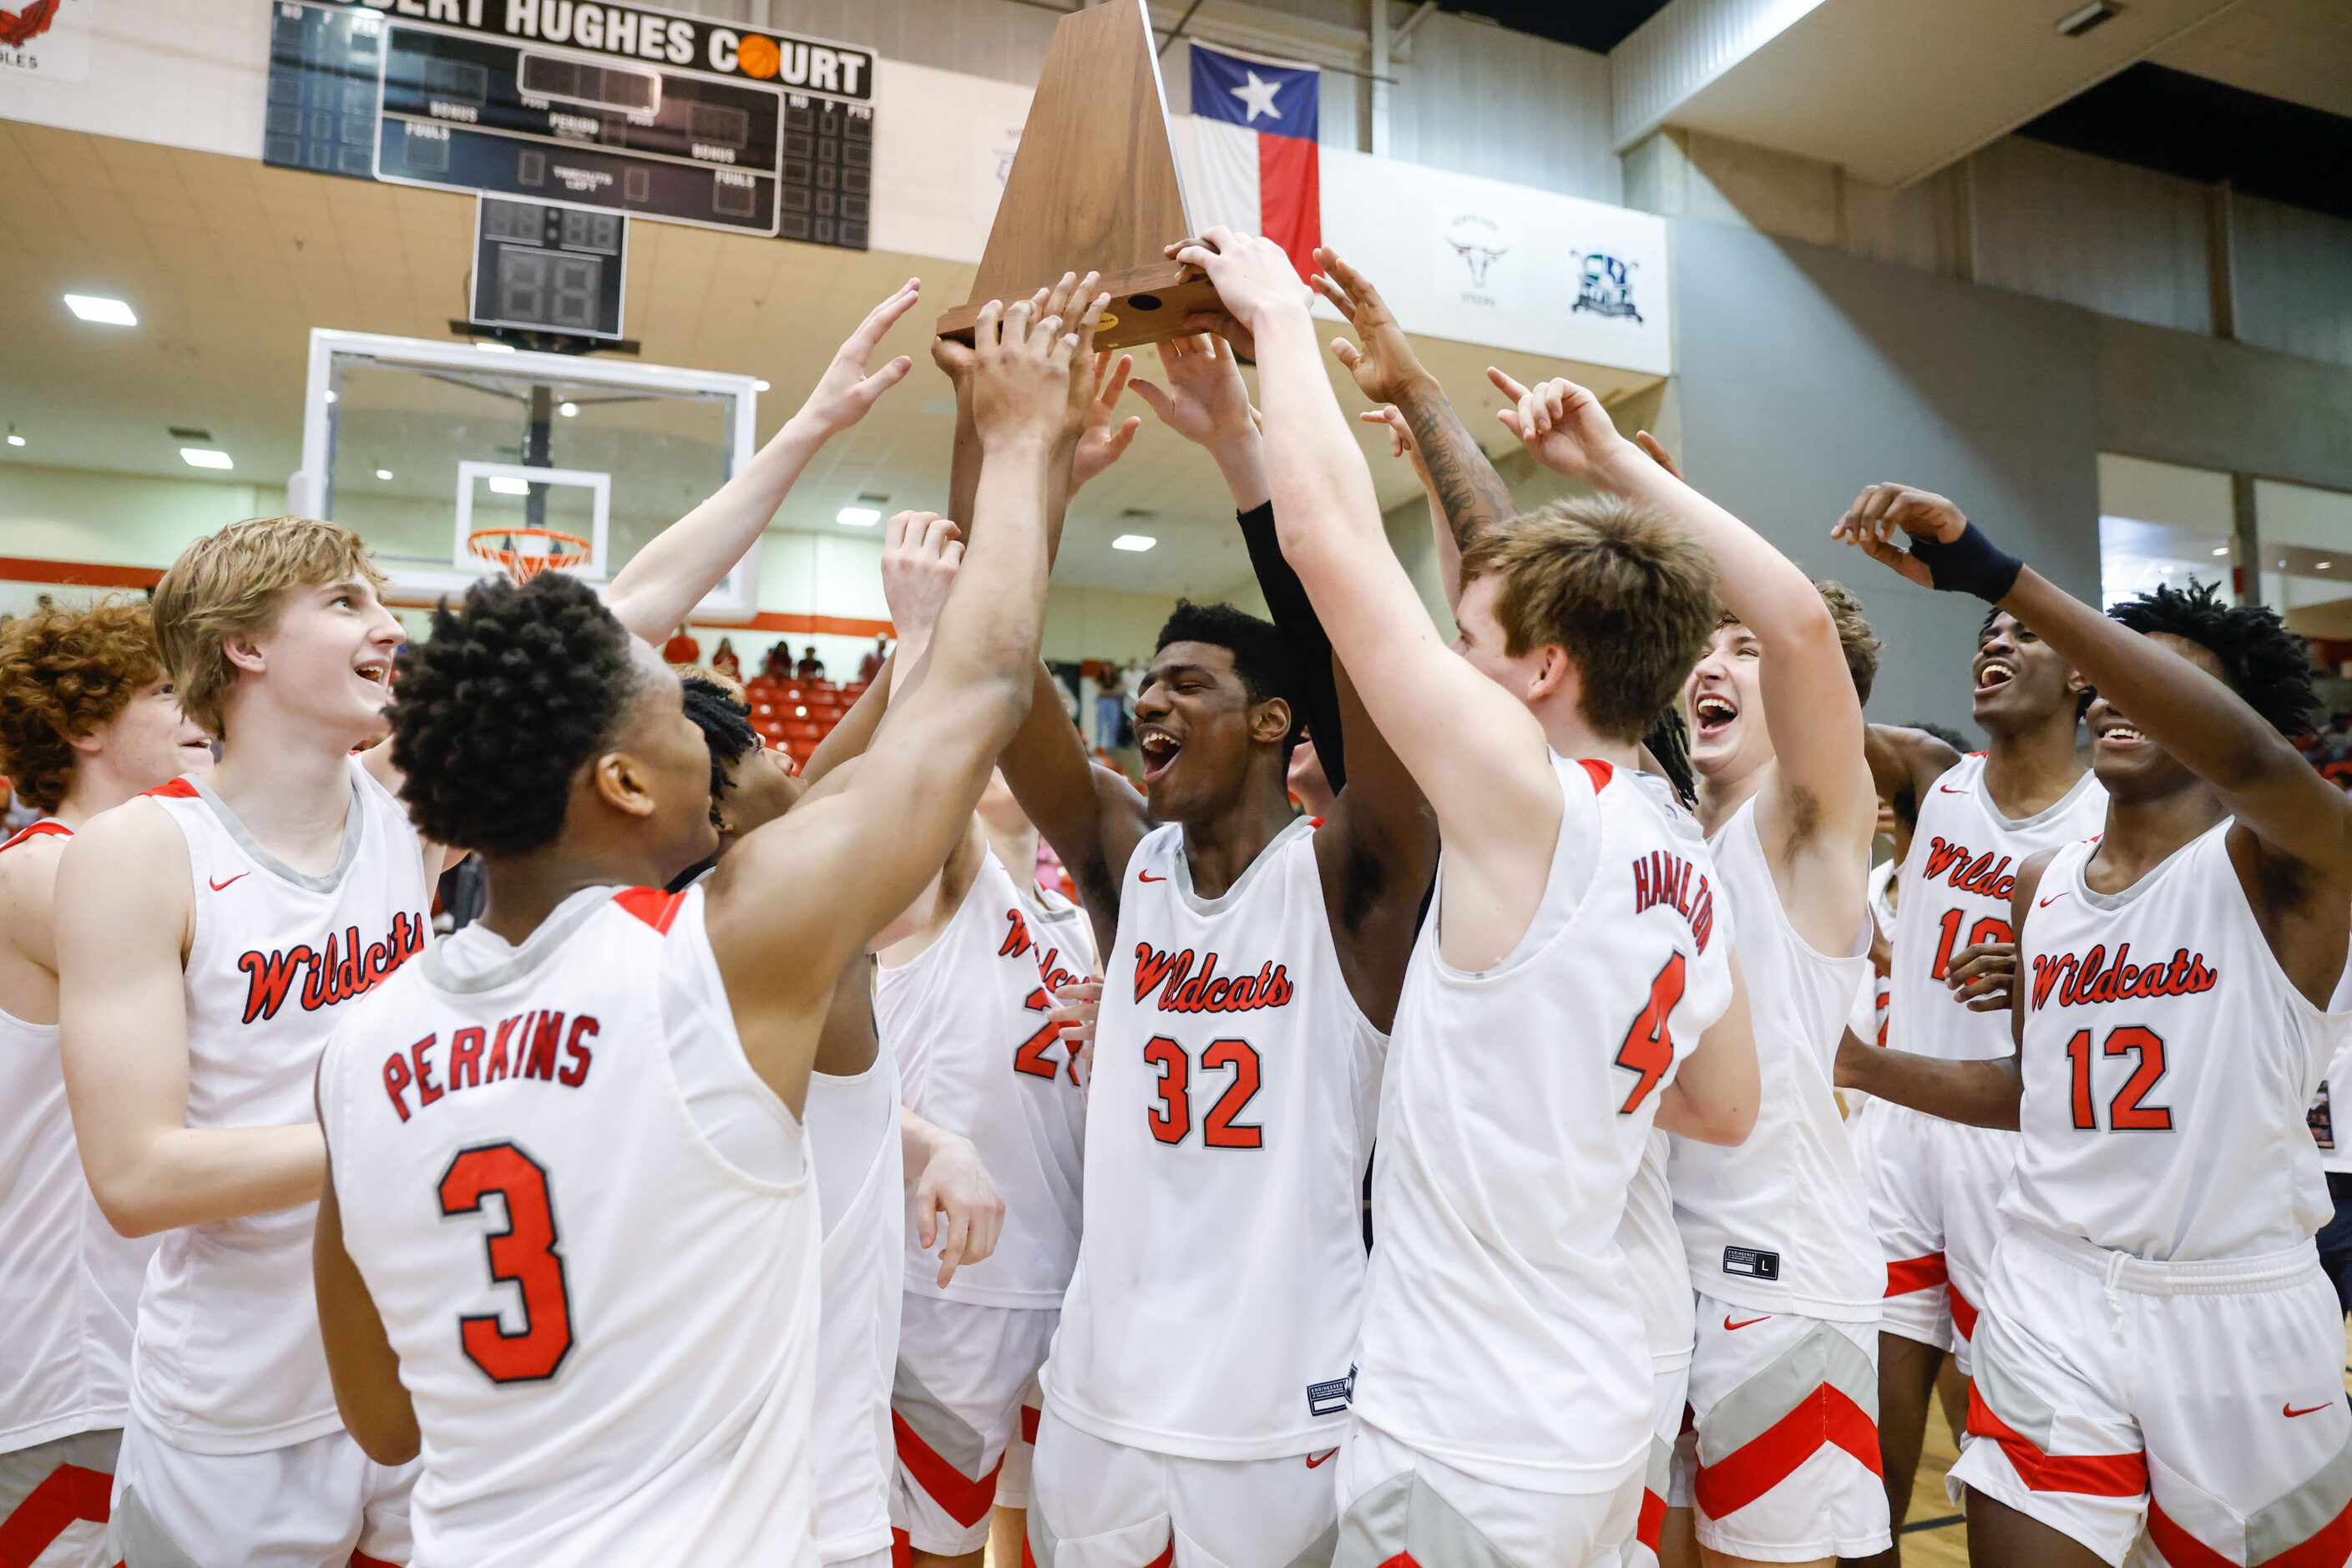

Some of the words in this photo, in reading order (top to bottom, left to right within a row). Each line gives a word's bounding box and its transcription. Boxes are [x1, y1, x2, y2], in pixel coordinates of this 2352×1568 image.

[505, 0, 695, 64] HUGHES
[405, 120, 451, 141] FOULS
[430, 100, 478, 124] BONUS
[549, 112, 599, 134] PERIOD
[691, 143, 736, 164] BONUS
[715, 169, 756, 188] FOULS
[238, 911, 425, 1024] Wildcts
[1134, 941, 1294, 1014] Wildcats
[2031, 943, 2218, 1013] Wildcats
[1615, 947, 1686, 1115] 4
[382, 1009, 599, 1124] PERKINS
[1143, 1034, 1266, 1151] 32
[2066, 1024, 2176, 1134] 12
[437, 1140, 574, 1384] 3
[1762, 1260, 1768, 1271] L
